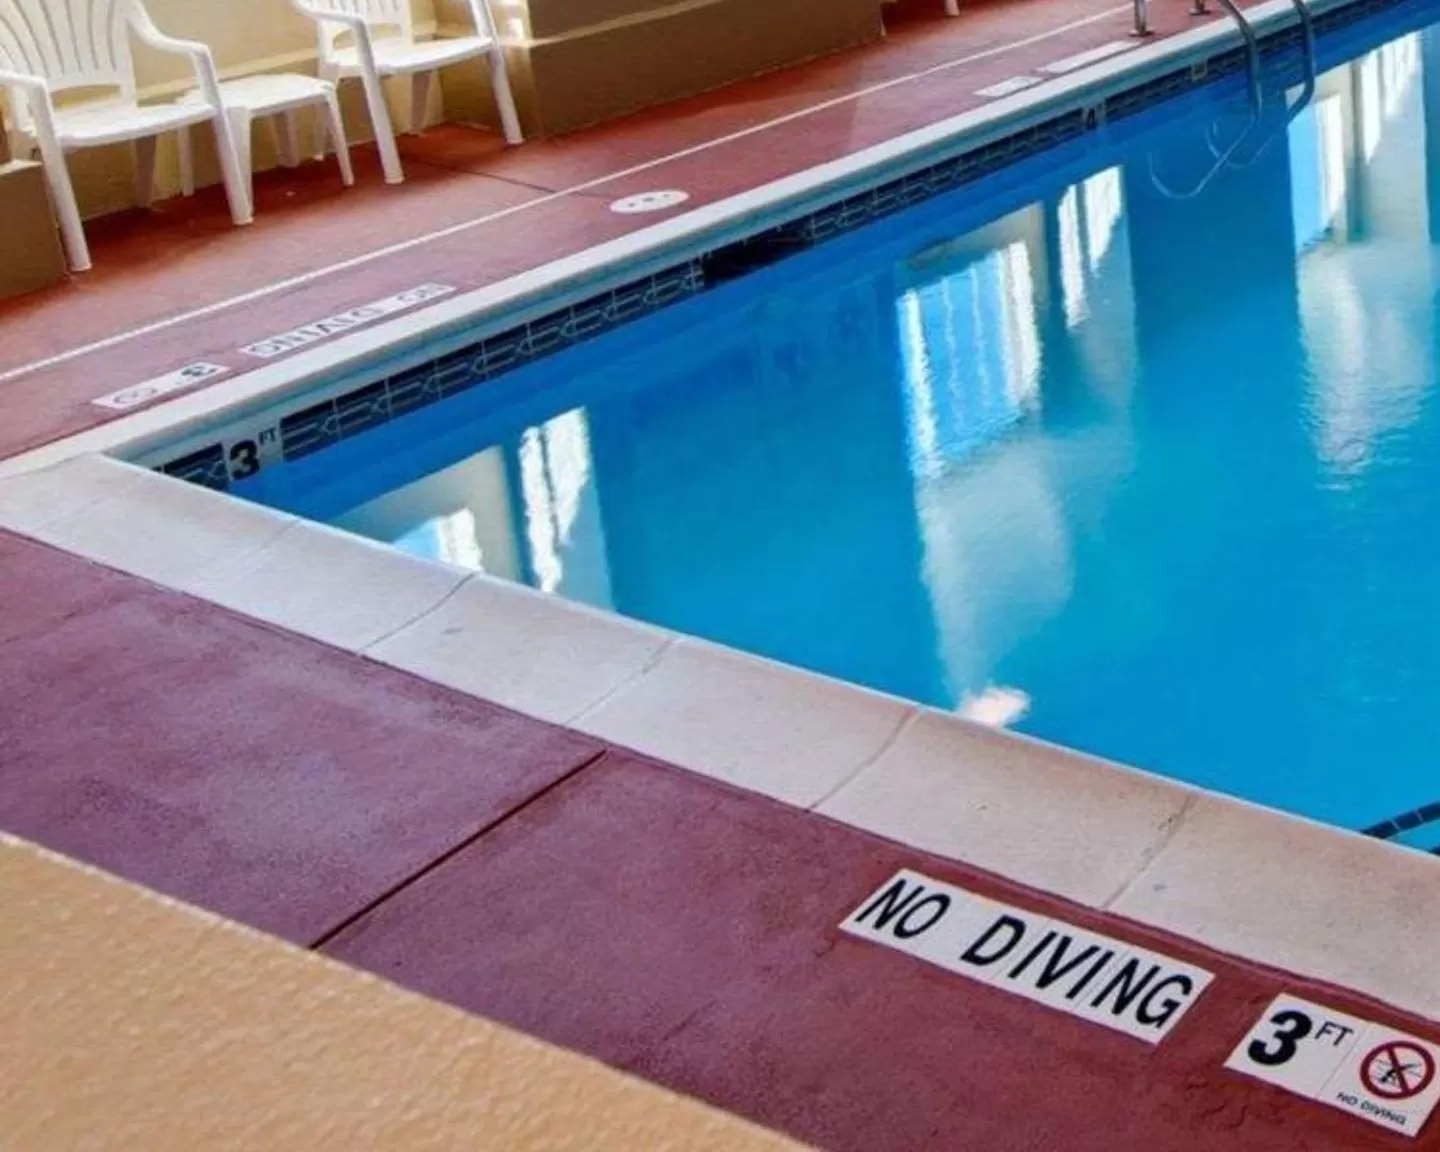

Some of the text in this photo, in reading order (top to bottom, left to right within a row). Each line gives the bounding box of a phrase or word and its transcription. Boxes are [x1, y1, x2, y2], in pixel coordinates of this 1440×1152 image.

[230, 426, 277, 479] 3 FT
[854, 878, 1194, 1029] NO DIVING
[1247, 1010, 1354, 1066] 3 FT
[1336, 1091, 1407, 1126] NO DIVING
